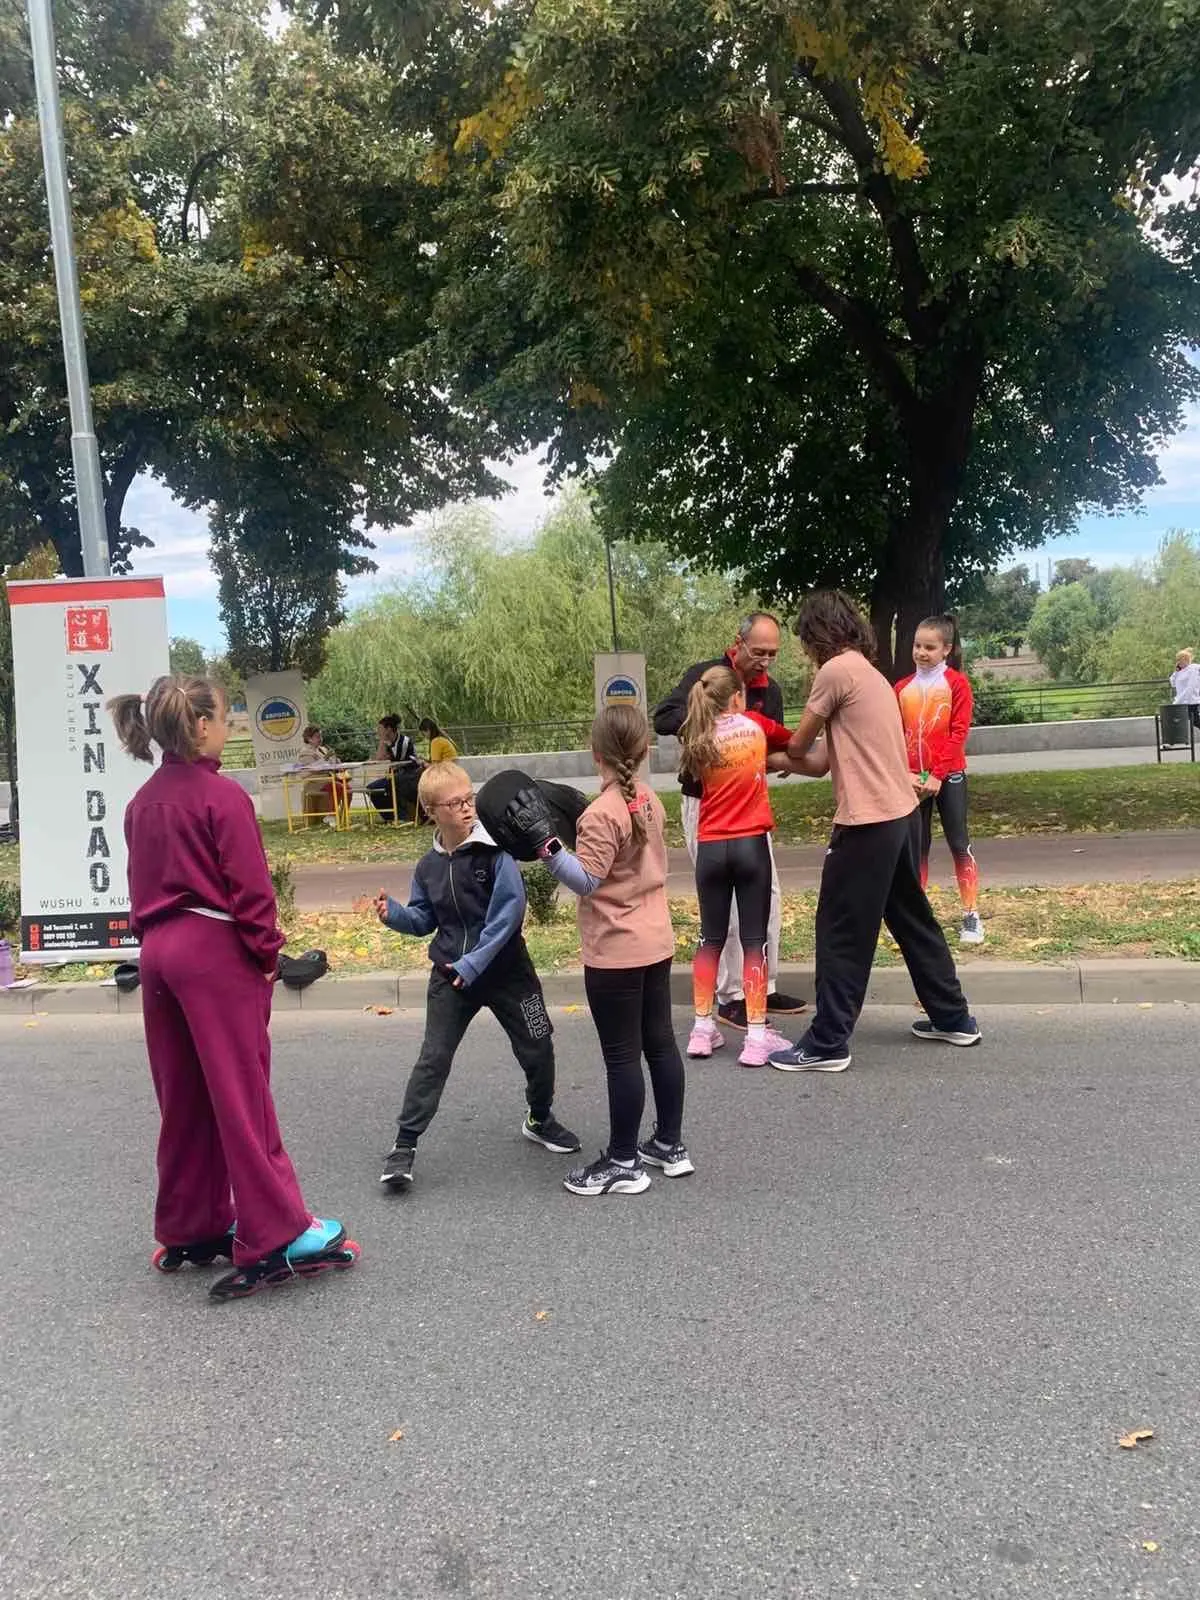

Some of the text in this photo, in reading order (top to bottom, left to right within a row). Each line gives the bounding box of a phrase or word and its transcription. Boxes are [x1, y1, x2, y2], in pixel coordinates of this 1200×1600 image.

[65, 663, 75, 699] CLUB
[76, 663, 111, 894] XIN DAO
[40, 898, 83, 909] WUSHU
[92, 897, 100, 907] &
